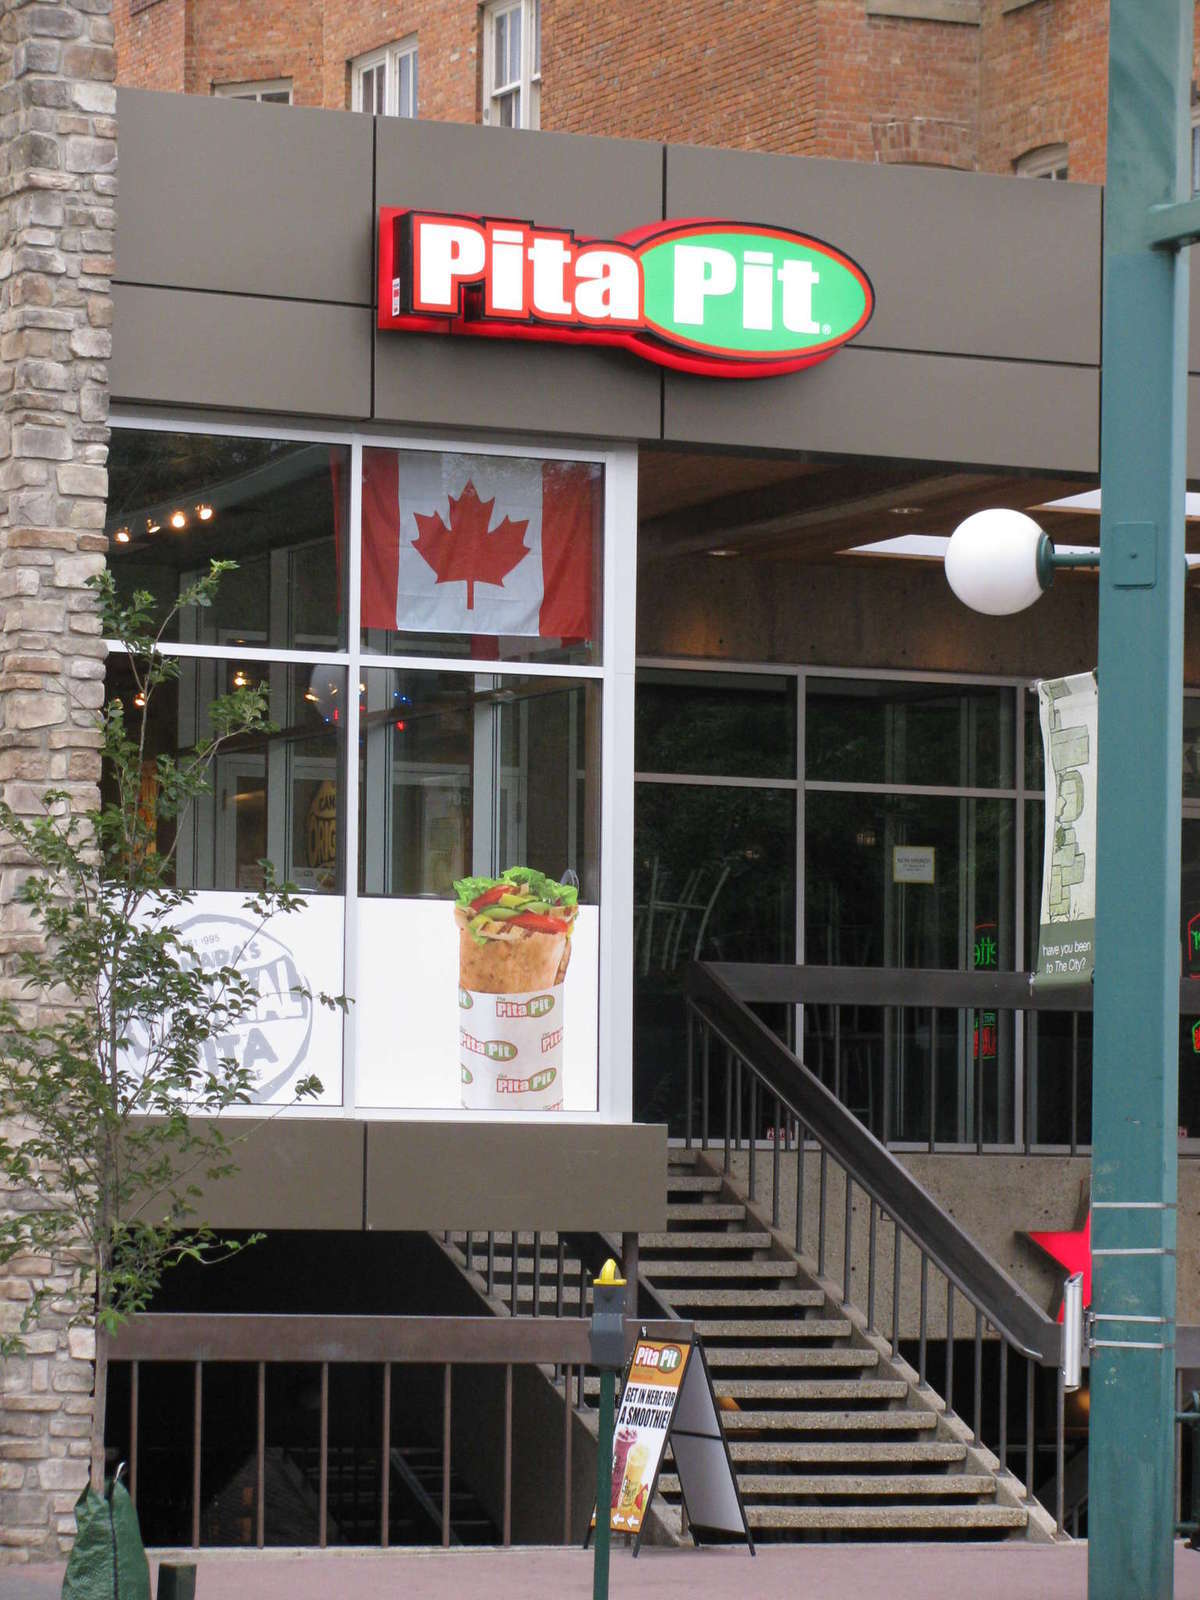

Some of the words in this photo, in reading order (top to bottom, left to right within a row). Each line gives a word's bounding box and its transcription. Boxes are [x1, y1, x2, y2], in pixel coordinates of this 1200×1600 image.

[419, 222, 639, 321] Pita
[673, 244, 820, 334] Pit
[1042, 944, 1060, 957] have
[1060, 944, 1073, 957] you
[1074, 941, 1091, 953] been
[1046, 962, 1054, 974] to
[1055, 960, 1067, 972] The
[1069, 957, 1087, 973] City?
[496, 1001, 528, 1018] Pita
[530, 999, 551, 1017] Pit
[488, 1043, 512, 1058] Pit
[497, 1078, 529, 1093] Pita
[635, 1346, 660, 1368] Pita
[660, 1348, 679, 1368] Pit
[625, 1387, 639, 1403] GET
[637, 1388, 647, 1404] IN
[645, 1389, 664, 1406] HERE
[662, 1391, 676, 1408] FOR
[619, 1406, 627, 1425] A
[626, 1406, 671, 1430] SMOOTHIE!
